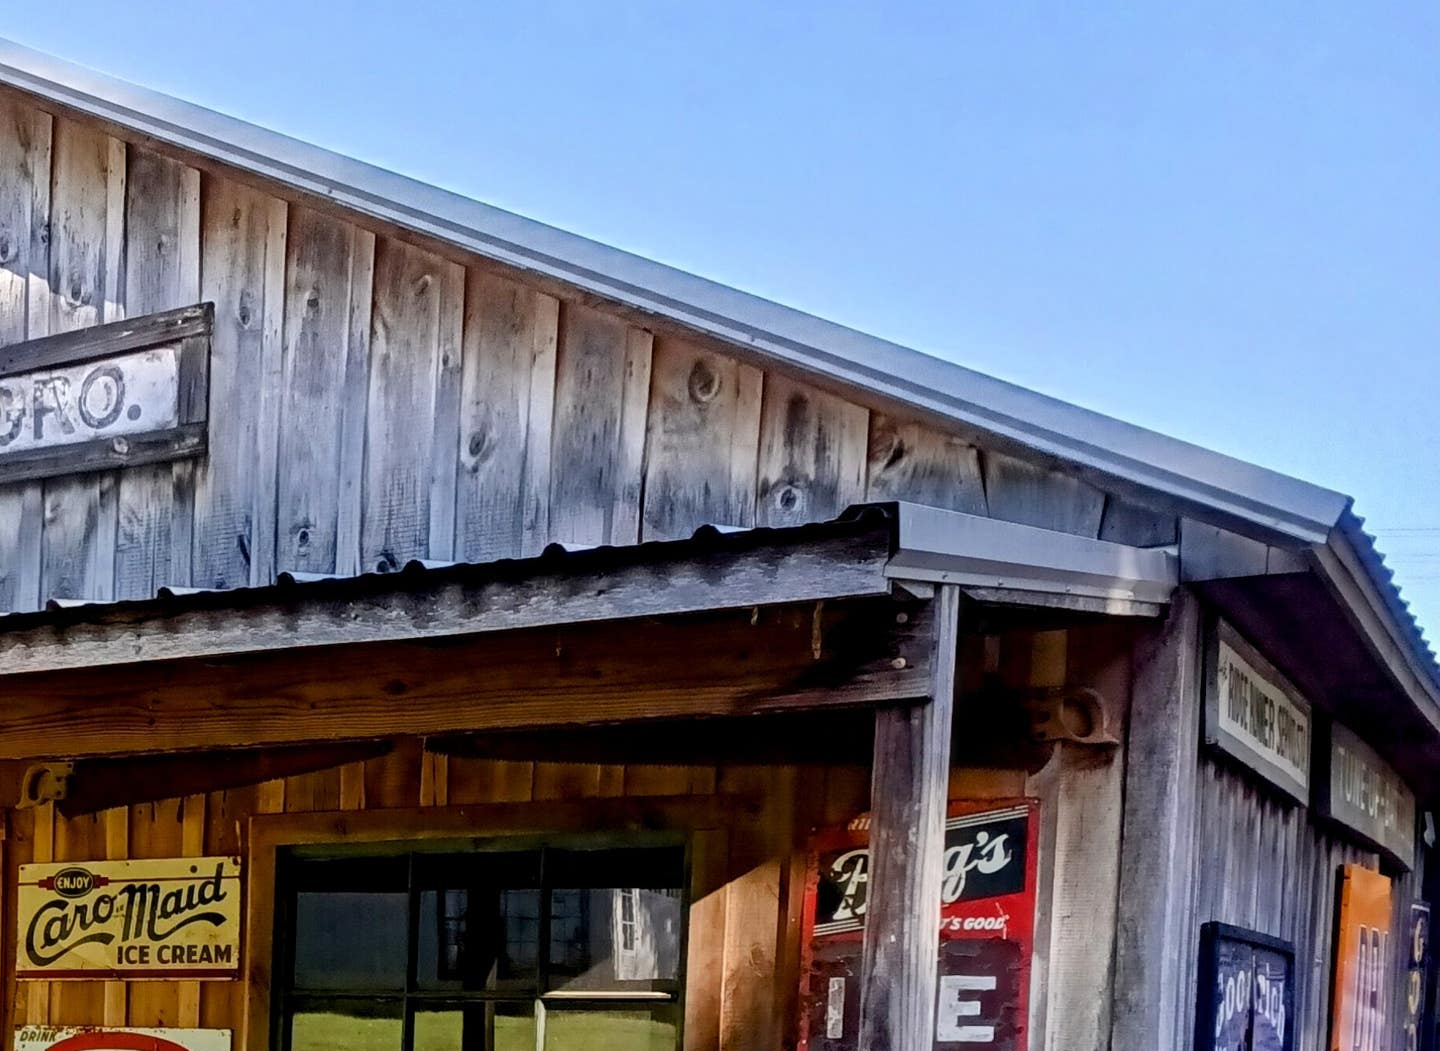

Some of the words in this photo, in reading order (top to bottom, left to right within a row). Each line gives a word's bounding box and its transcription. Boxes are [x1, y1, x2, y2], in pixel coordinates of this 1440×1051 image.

[56, 875, 90, 889] ENJOY
[117, 862, 227, 942] Maid
[963, 916, 1006, 930] GOOD
[117, 946, 150, 965] ICE
[157, 944, 232, 964] CREAM
[826, 976, 997, 1042] IE
[19, 1030, 57, 1042] DRINK
